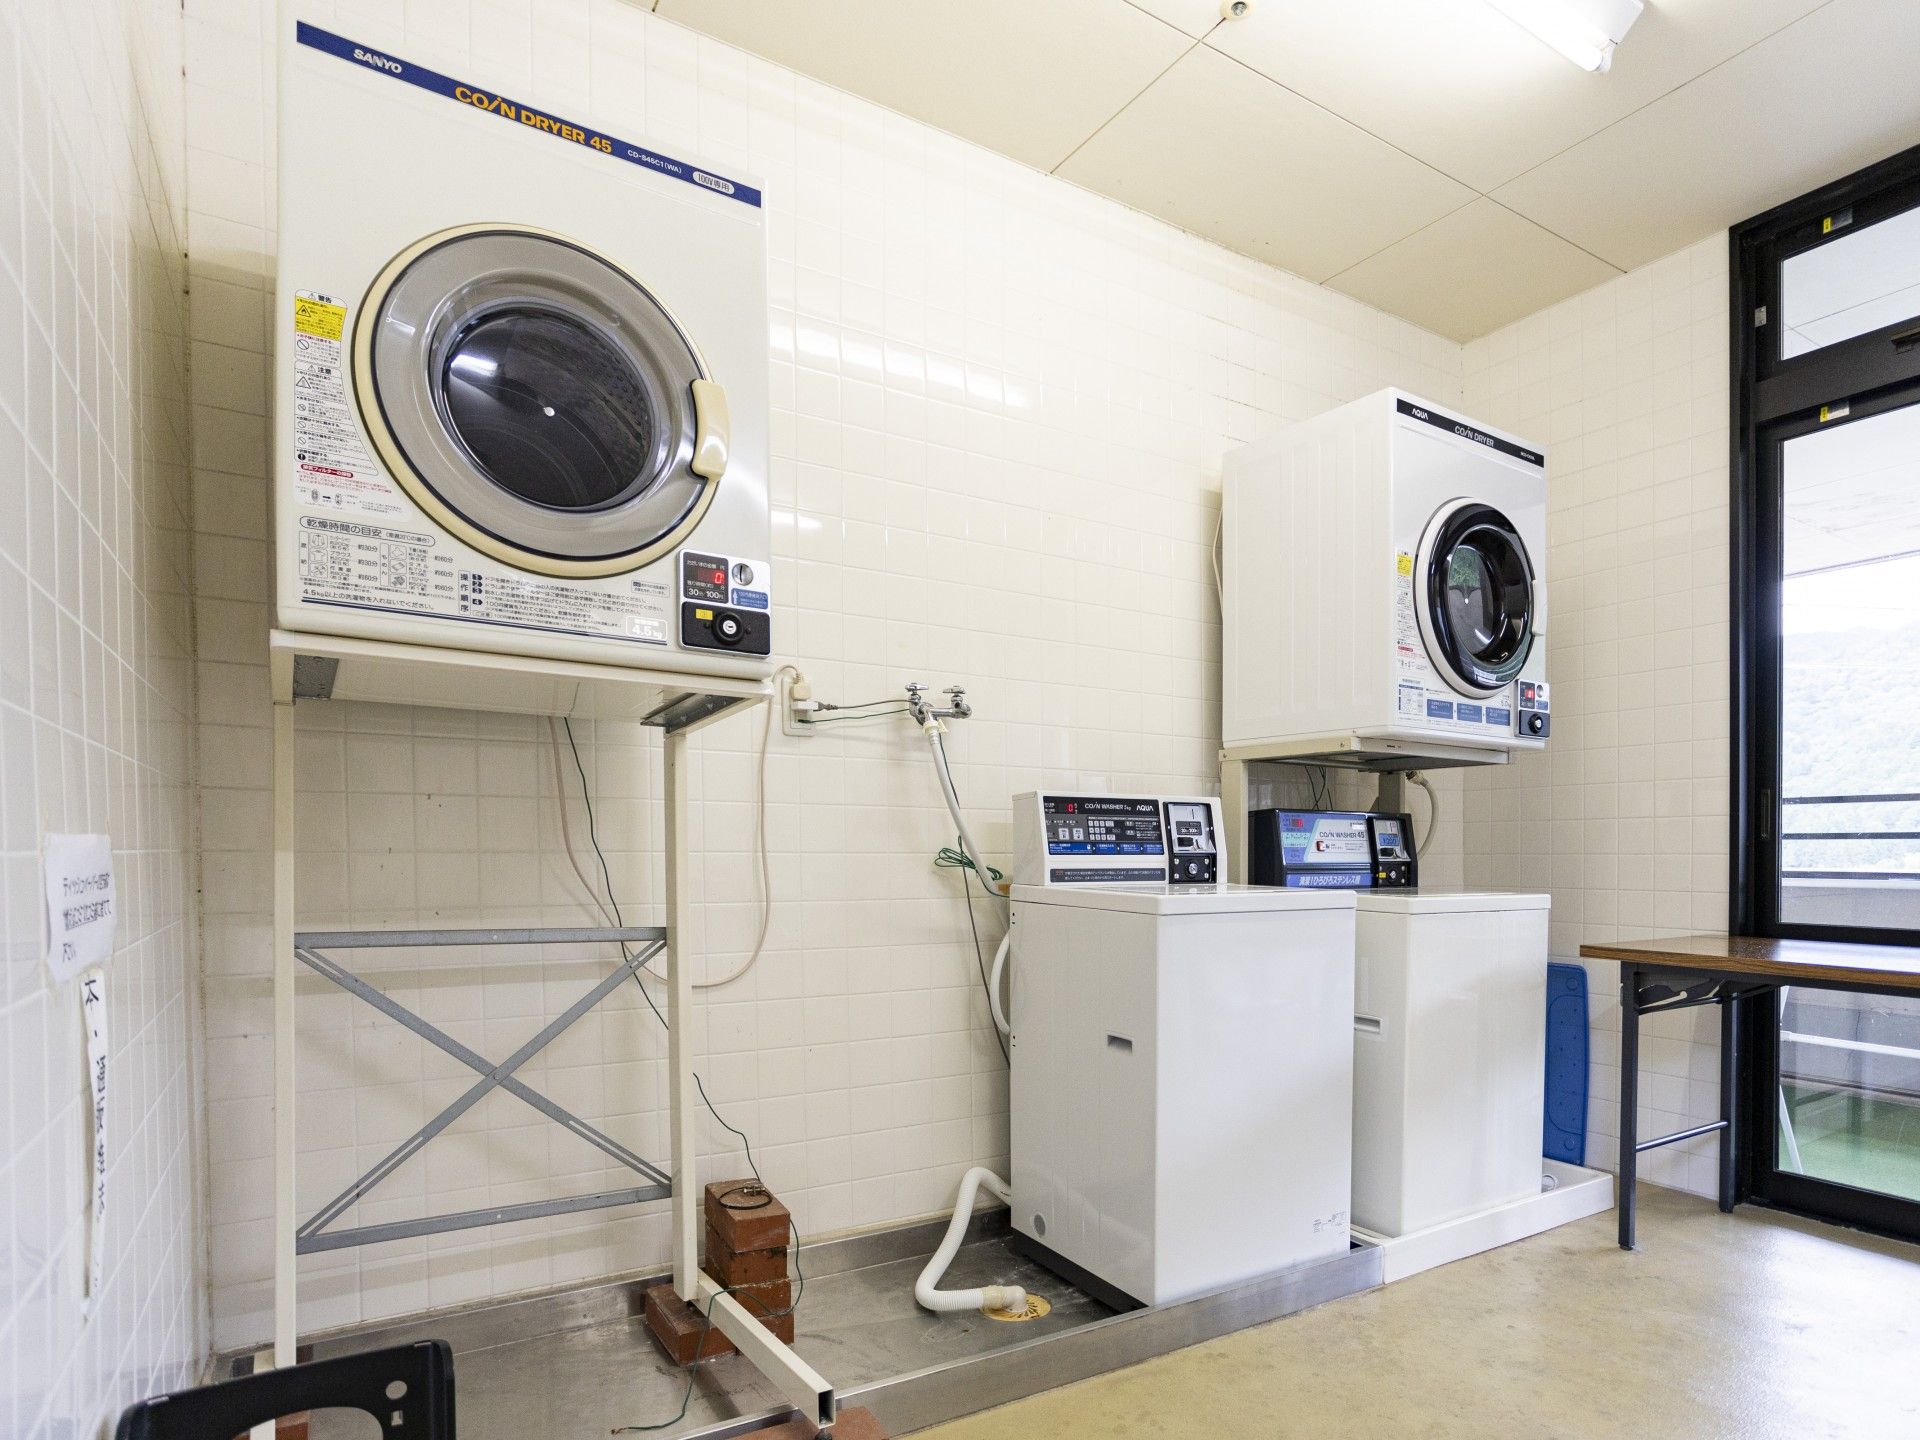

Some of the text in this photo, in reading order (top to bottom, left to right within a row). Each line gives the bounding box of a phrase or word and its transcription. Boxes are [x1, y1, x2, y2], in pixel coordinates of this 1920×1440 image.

[353, 48, 403, 74] SANYO
[455, 86, 612, 154] COIN DRYER 45
[318, 366, 331, 375] 注意
[1412, 408, 1429, 421] AQUA
[1474, 433, 1494, 447] DRYER
[306, 519, 382, 537] 乾燥時間の目安
